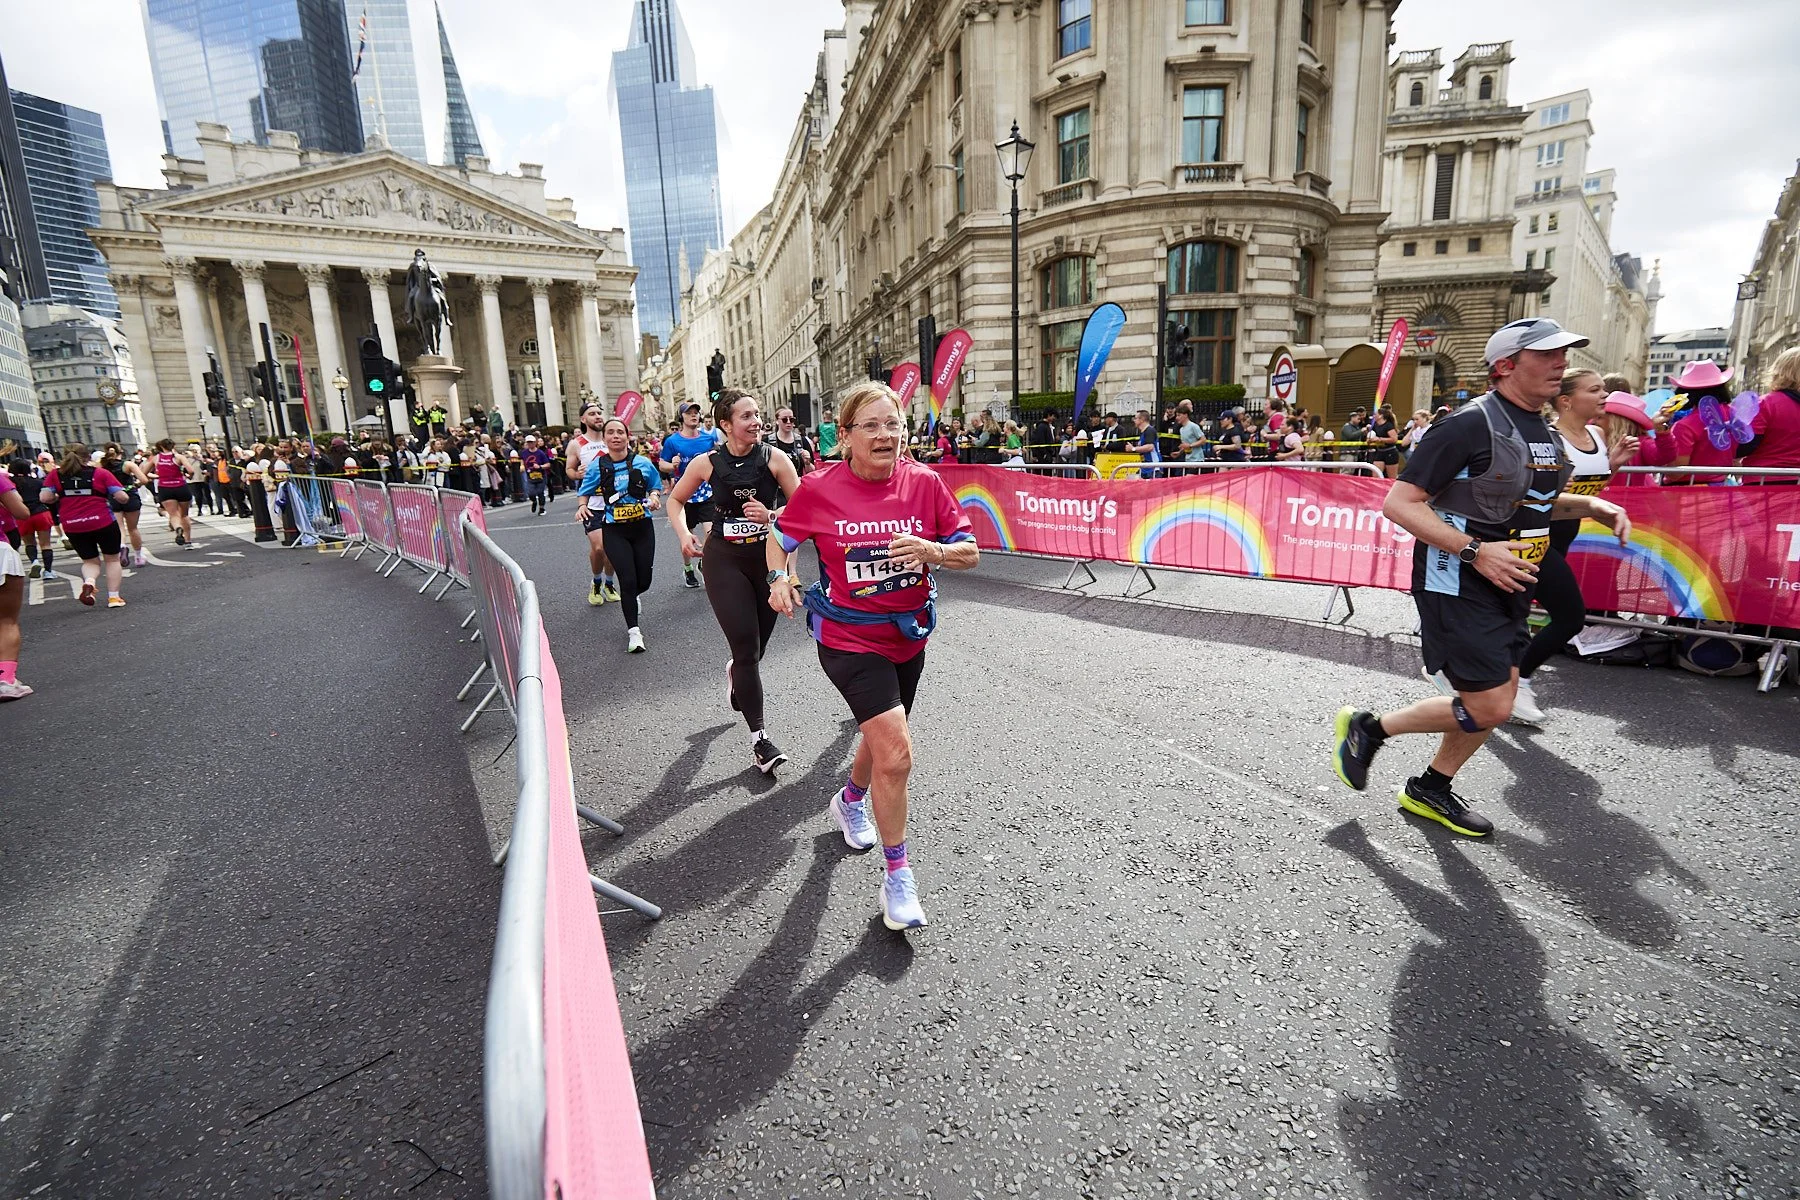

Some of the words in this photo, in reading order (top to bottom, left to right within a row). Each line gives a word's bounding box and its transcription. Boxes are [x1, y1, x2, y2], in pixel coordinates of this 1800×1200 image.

[936, 340, 962, 385] Tommy's
[1015, 490, 1117, 522] Tommy's
[835, 516, 923, 535] Tommy's
[1017, 518, 1027, 526] The
[1027, 521, 1058, 531] pregnancy
[1059, 523, 1071, 531] and
[1072, 524, 1089, 534] baby
[847, 540, 879, 548] pregnancy
[1283, 534, 1297, 543] The
[1300, 538, 1347, 552] pregnancy
[1350, 543, 1370, 552] and
[1373, 543, 1401, 557] baby
[853, 561, 915, 579] 1148
[1766, 577, 1800, 591] The
